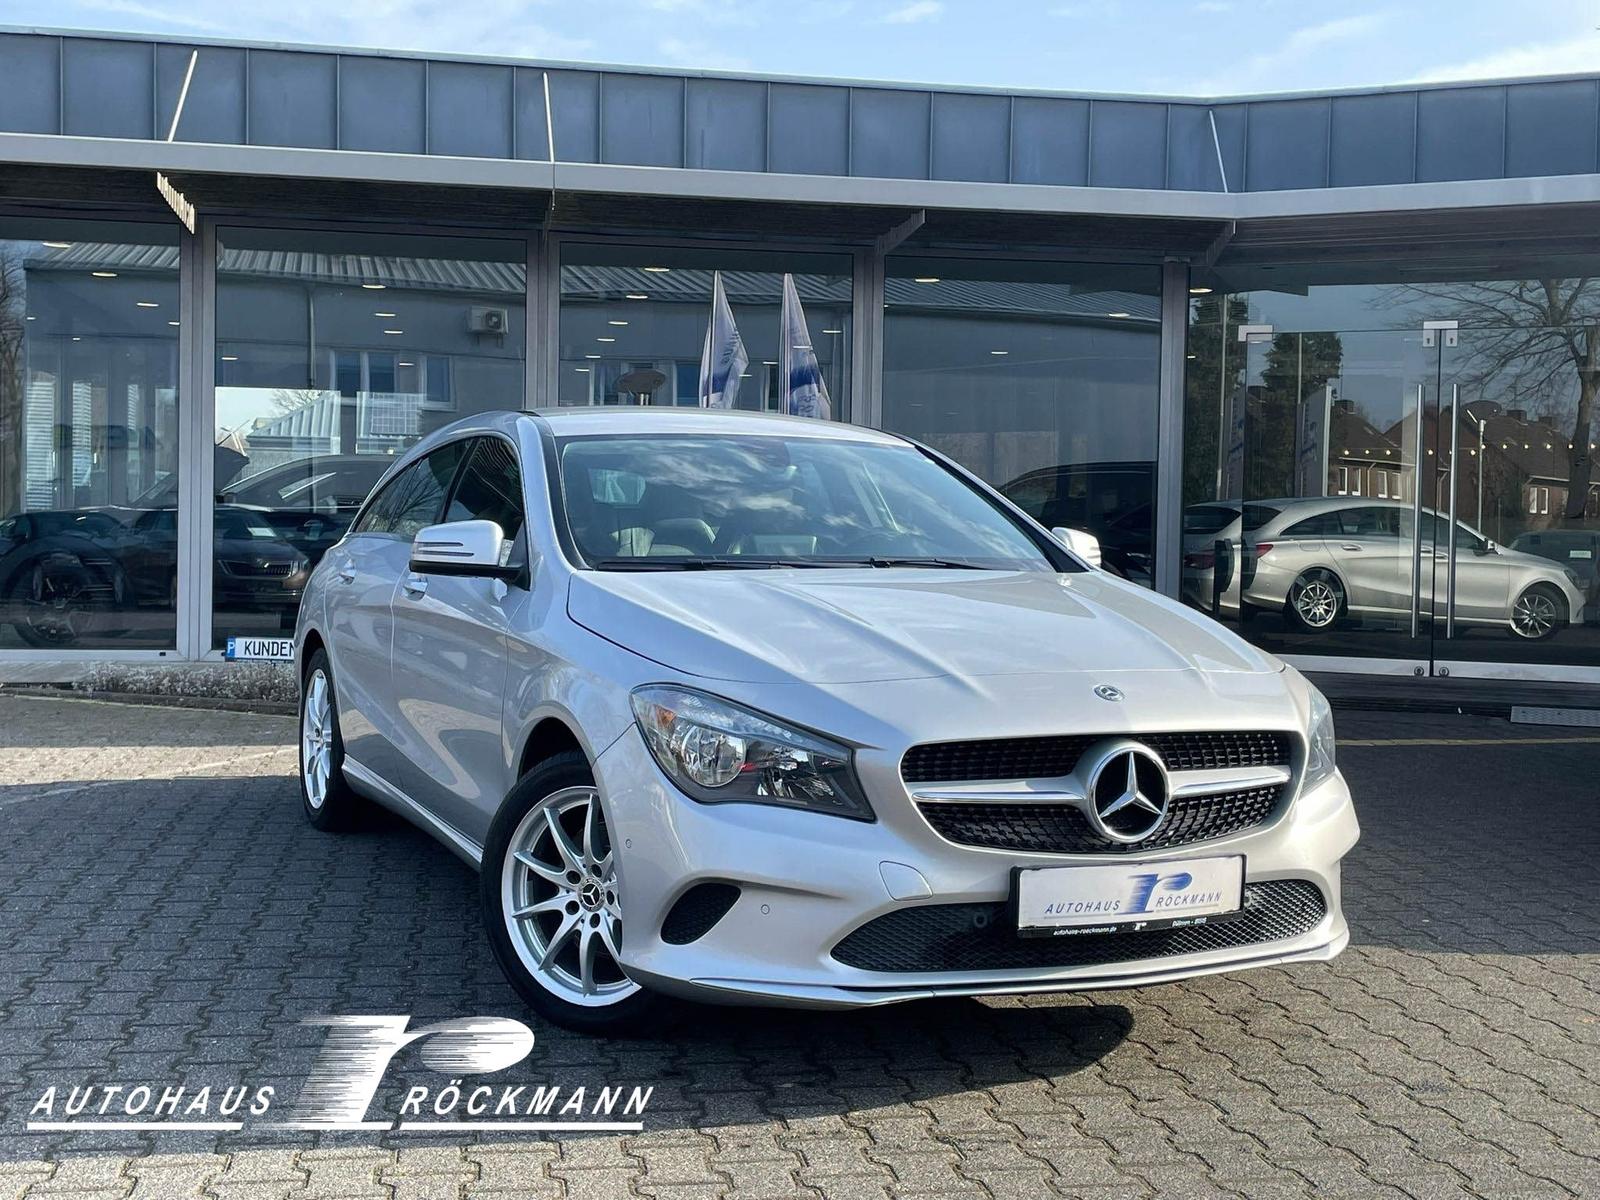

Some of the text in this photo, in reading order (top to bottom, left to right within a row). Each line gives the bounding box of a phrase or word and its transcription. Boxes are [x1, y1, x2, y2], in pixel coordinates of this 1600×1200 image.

[227, 641, 235, 654] P
[1044, 890, 1222, 914] AUTOHAUS RÖCKMANN
